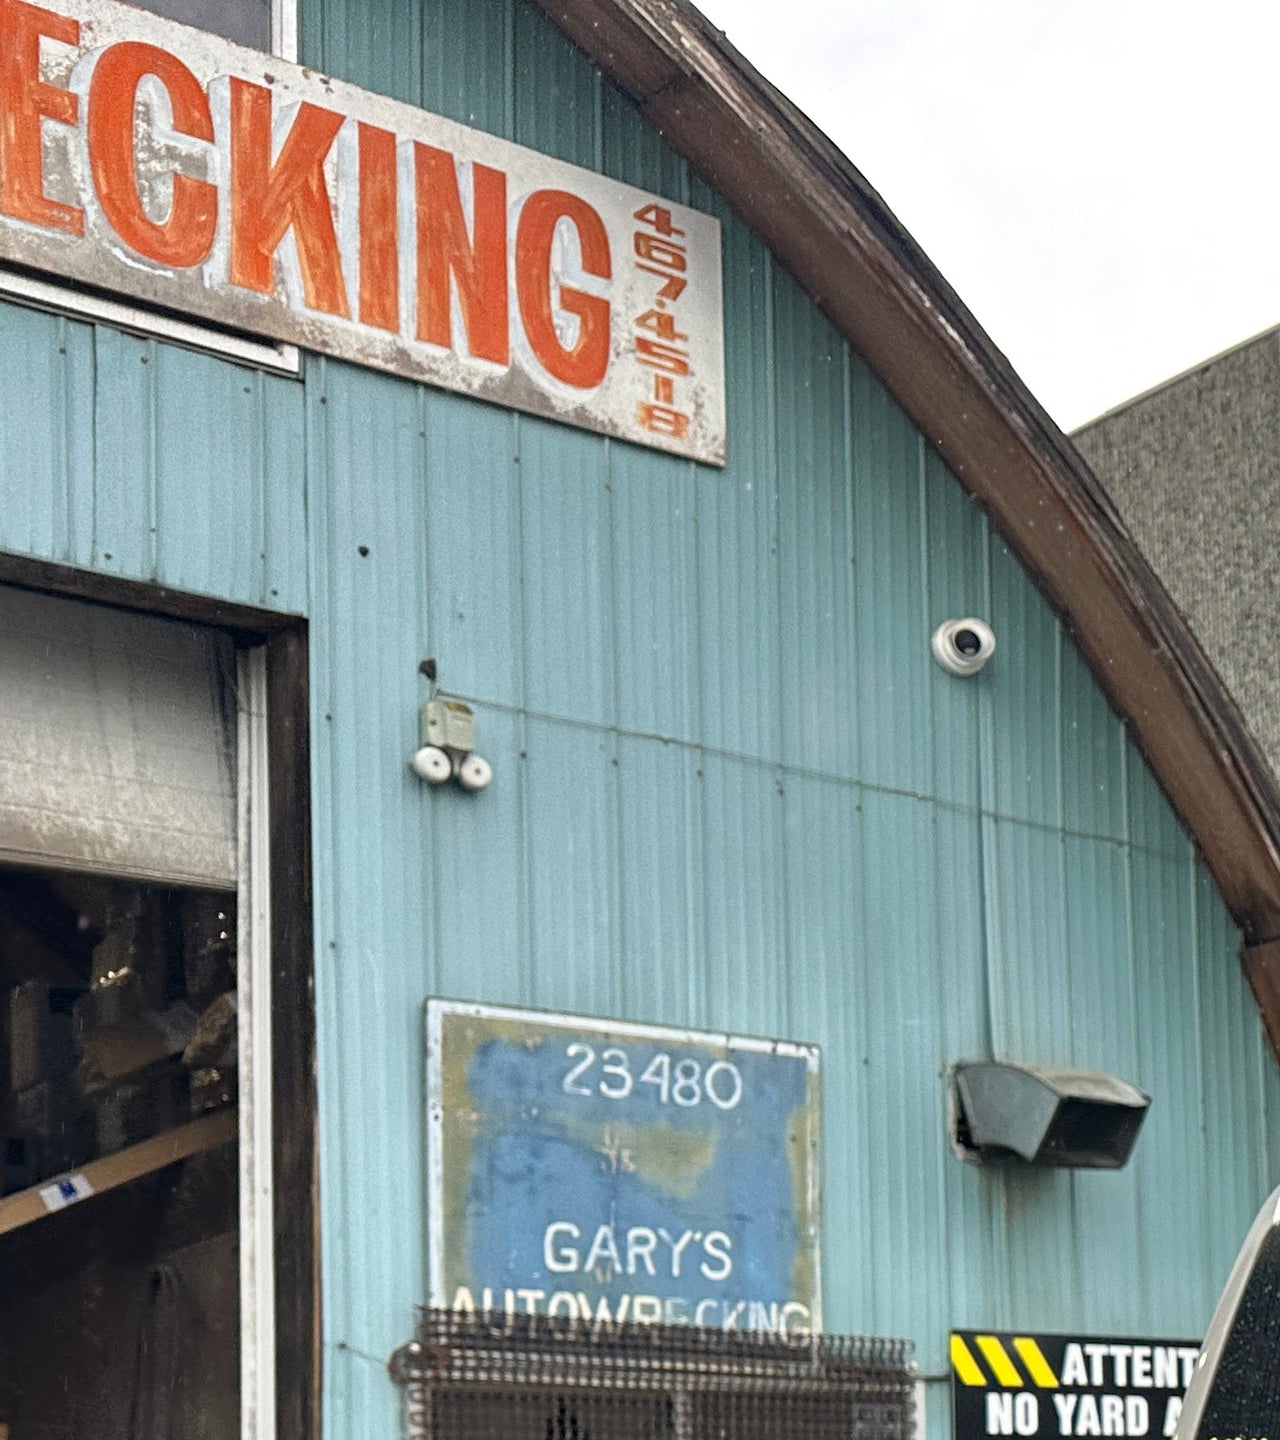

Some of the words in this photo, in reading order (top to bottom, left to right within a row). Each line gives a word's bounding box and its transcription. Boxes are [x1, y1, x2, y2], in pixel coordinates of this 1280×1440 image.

[563, 1042, 743, 1110] 23480
[544, 1222, 733, 1281] GARY'S
[986, 1392, 1039, 1436] NO
[1053, 1393, 1150, 1437] YARD
